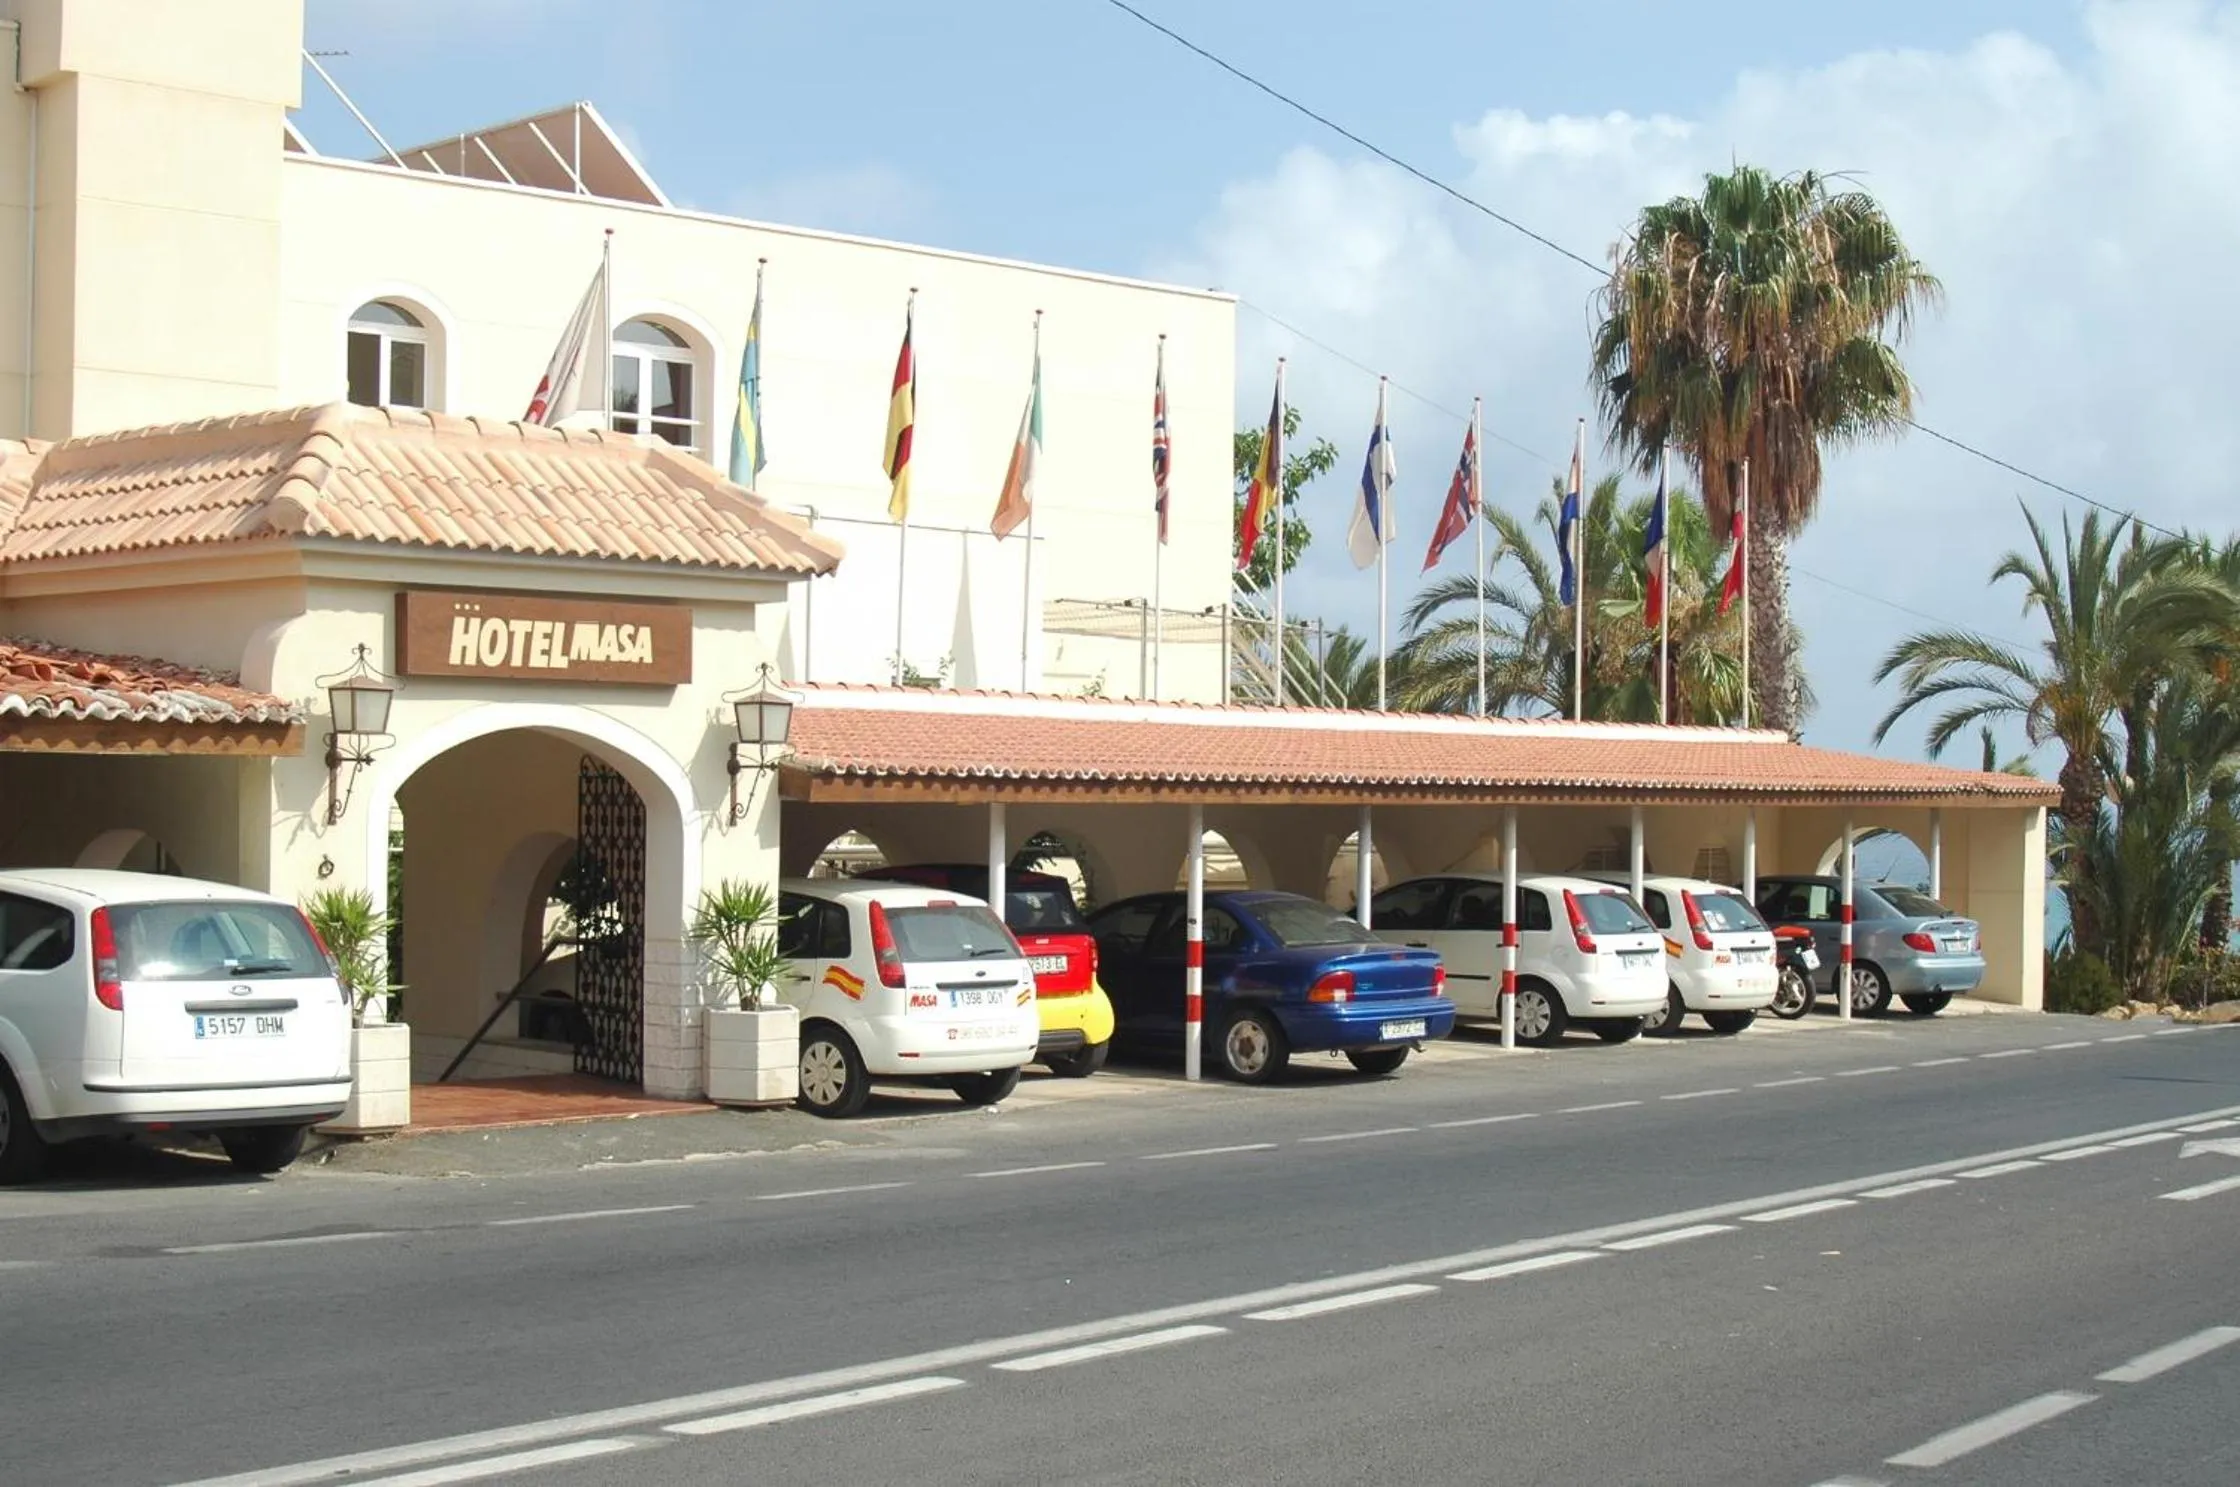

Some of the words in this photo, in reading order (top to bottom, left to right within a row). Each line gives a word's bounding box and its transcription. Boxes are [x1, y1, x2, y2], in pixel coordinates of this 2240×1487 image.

[448, 616, 569, 669] HOTEL
[569, 621, 653, 664] MASA
[909, 994, 938, 1008] MASA
[208, 1017, 246, 1035] 5157
[255, 1016, 285, 1034] DHM
